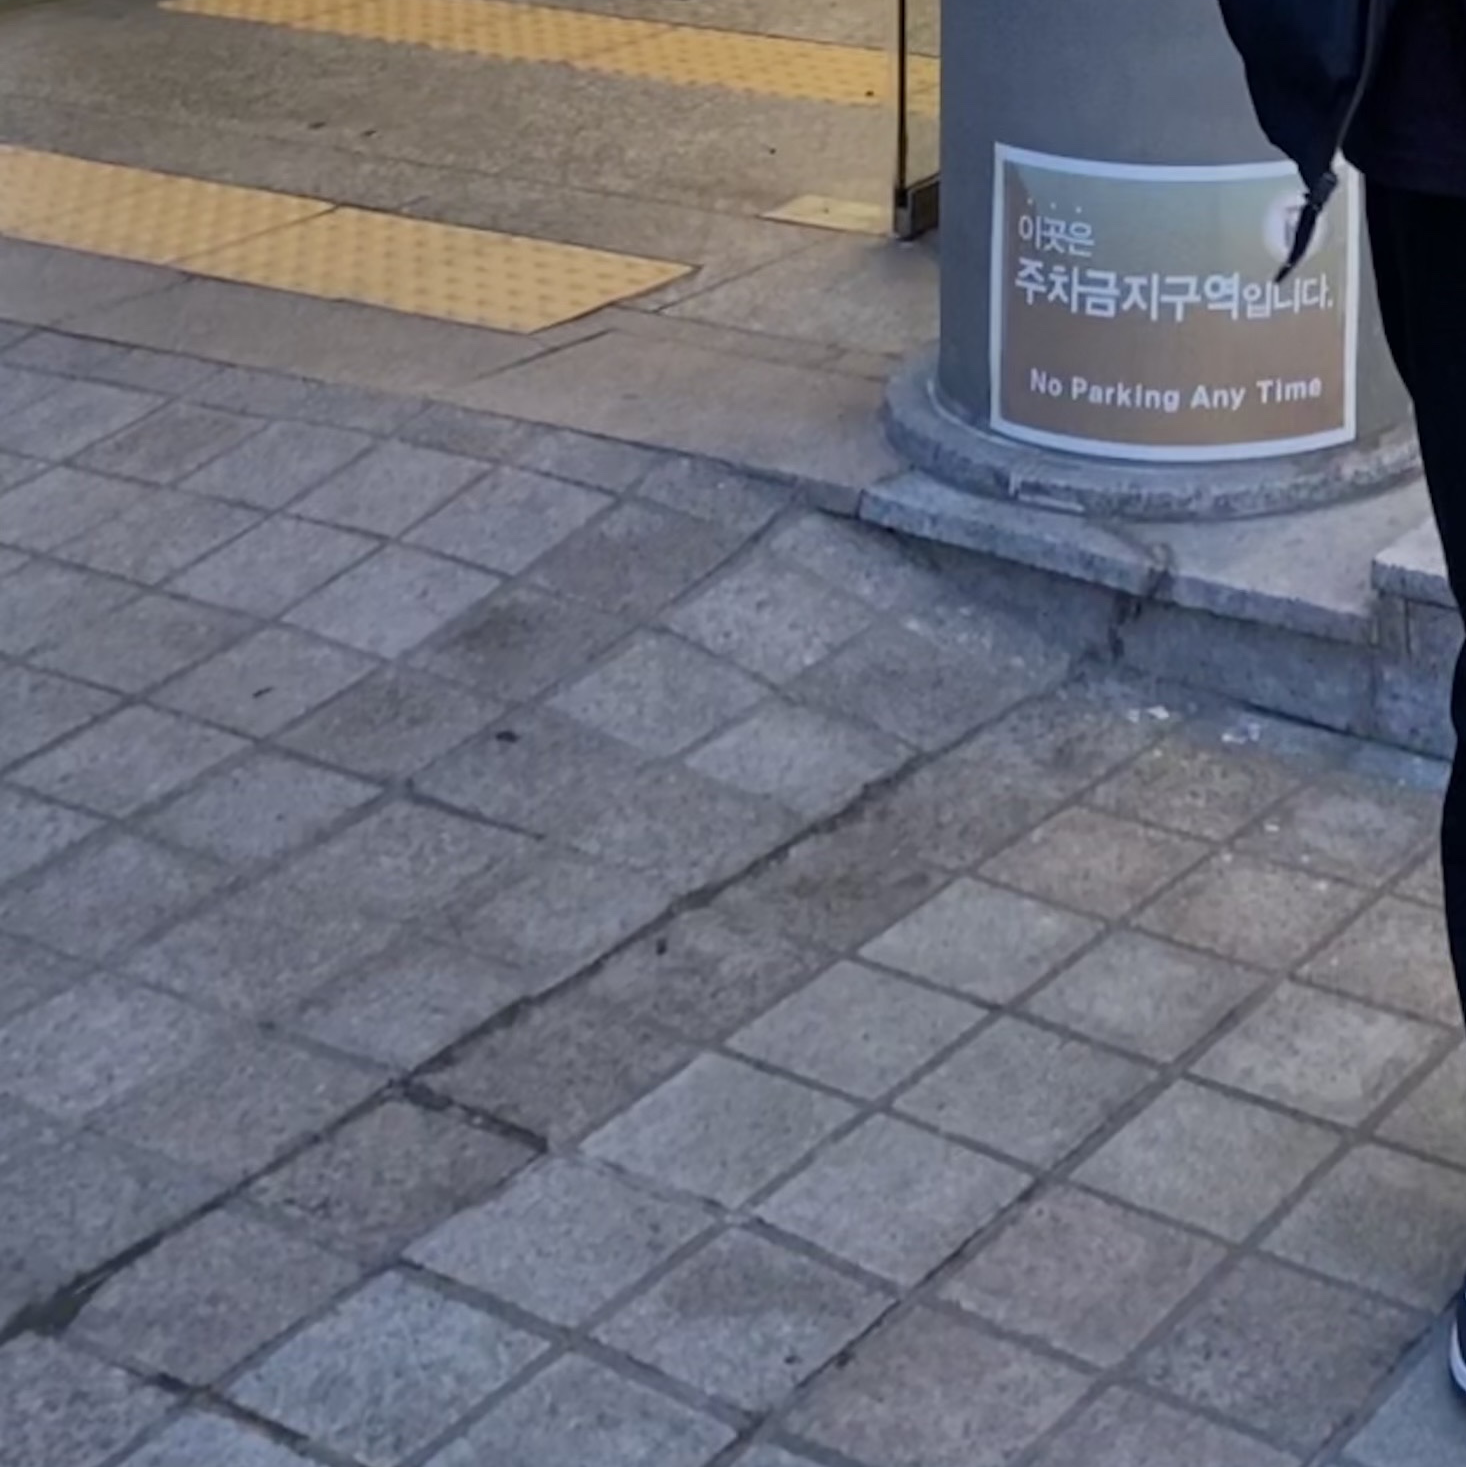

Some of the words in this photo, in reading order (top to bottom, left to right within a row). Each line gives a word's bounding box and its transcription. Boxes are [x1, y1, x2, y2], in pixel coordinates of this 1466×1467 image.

[1018, 214, 1095, 257] 이곳은
[1014, 256, 1334, 322] 주차금지구역입니다.
[1030, 367, 1063, 397] No
[1070, 375, 1181, 413] Parking
[1190, 384, 1246, 411] Any
[1256, 377, 1322, 404] Time
